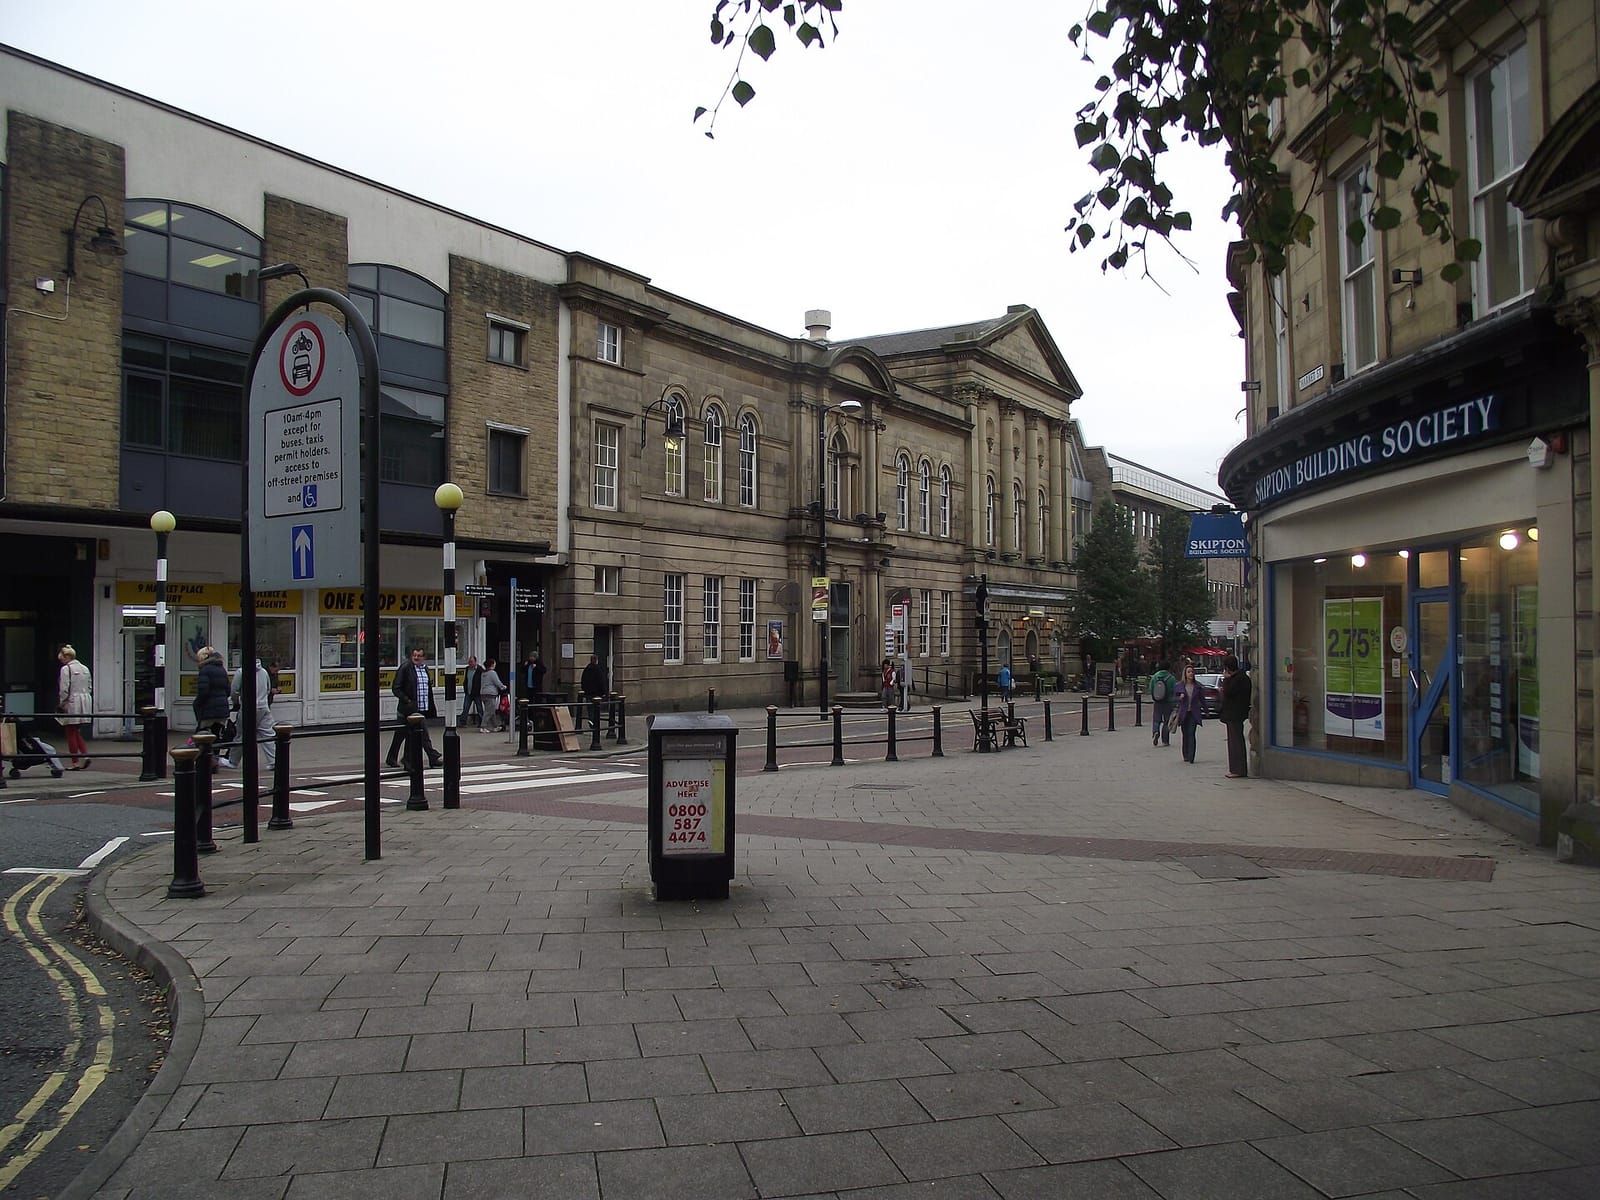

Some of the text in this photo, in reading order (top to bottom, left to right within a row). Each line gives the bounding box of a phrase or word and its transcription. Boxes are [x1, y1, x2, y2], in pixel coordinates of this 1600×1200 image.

[283, 410, 322, 424] 10am-4pm
[283, 422, 321, 436] except for
[306, 434, 324, 445] taxis
[1255, 395, 1494, 503] SKIPTON BUILDING SOCIETY
[274, 450, 298, 464] permit
[285, 461, 320, 473] access to
[267, 471, 339, 488] off-street premises
[287, 492, 302, 503] and
[1190, 539, 1245, 550] SKIPTON
[137, 583, 144, 593] 9
[180, 585, 204, 594] PLACE
[168, 595, 183, 603] URY
[323, 591, 442, 611] ONE SOP SAVER
[668, 804, 707, 817] 0800
[673, 818, 702, 830] 587
[668, 831, 706, 843] 4474
